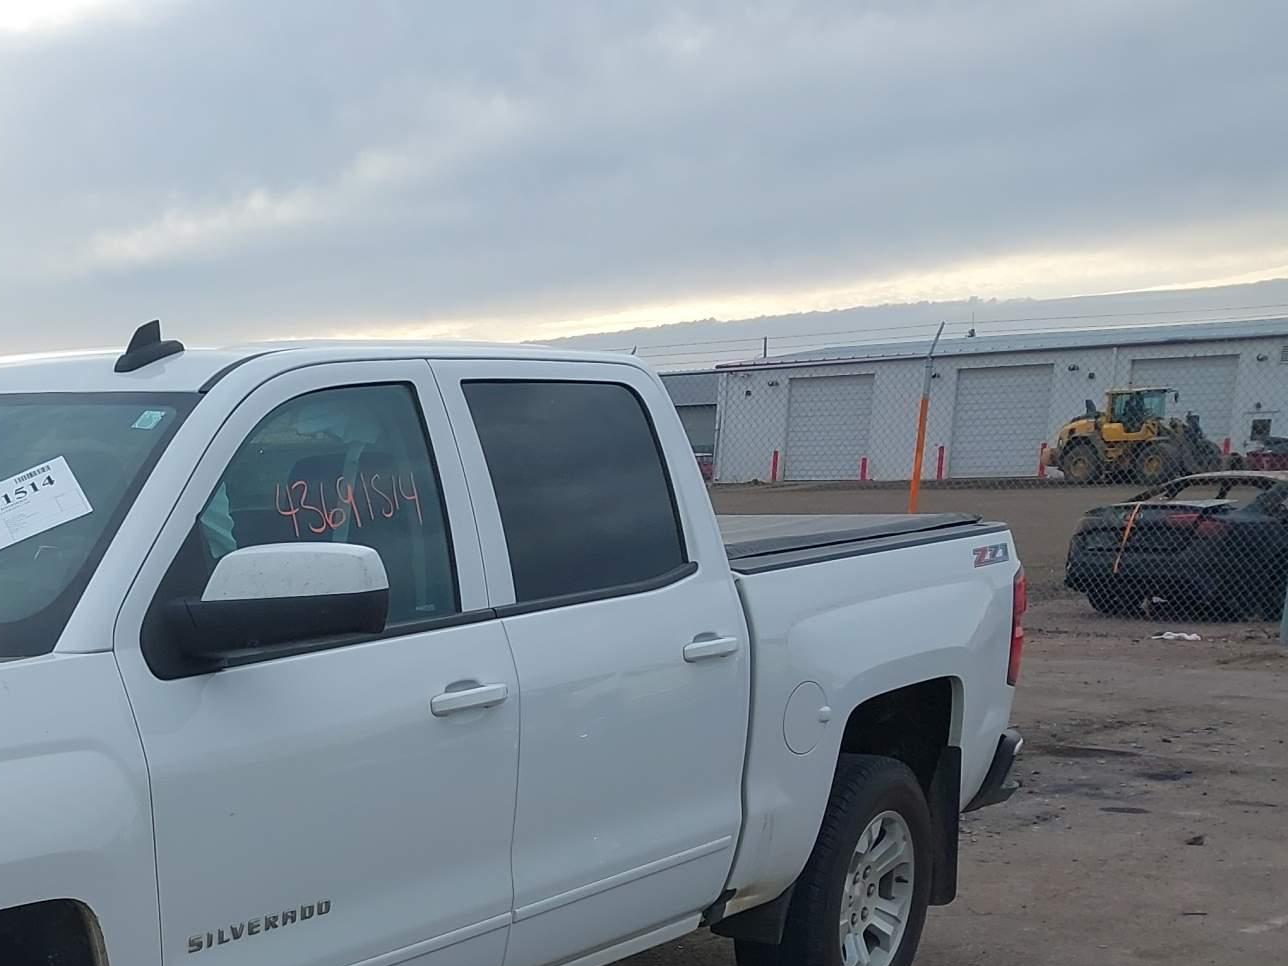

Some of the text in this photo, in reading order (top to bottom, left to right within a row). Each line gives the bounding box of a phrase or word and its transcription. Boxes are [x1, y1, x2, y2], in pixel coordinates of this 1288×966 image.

[275, 471, 423, 538] 43691514
[973, 543, 1010, 568] Z71
[187, 900, 332, 953] SILVERADO
